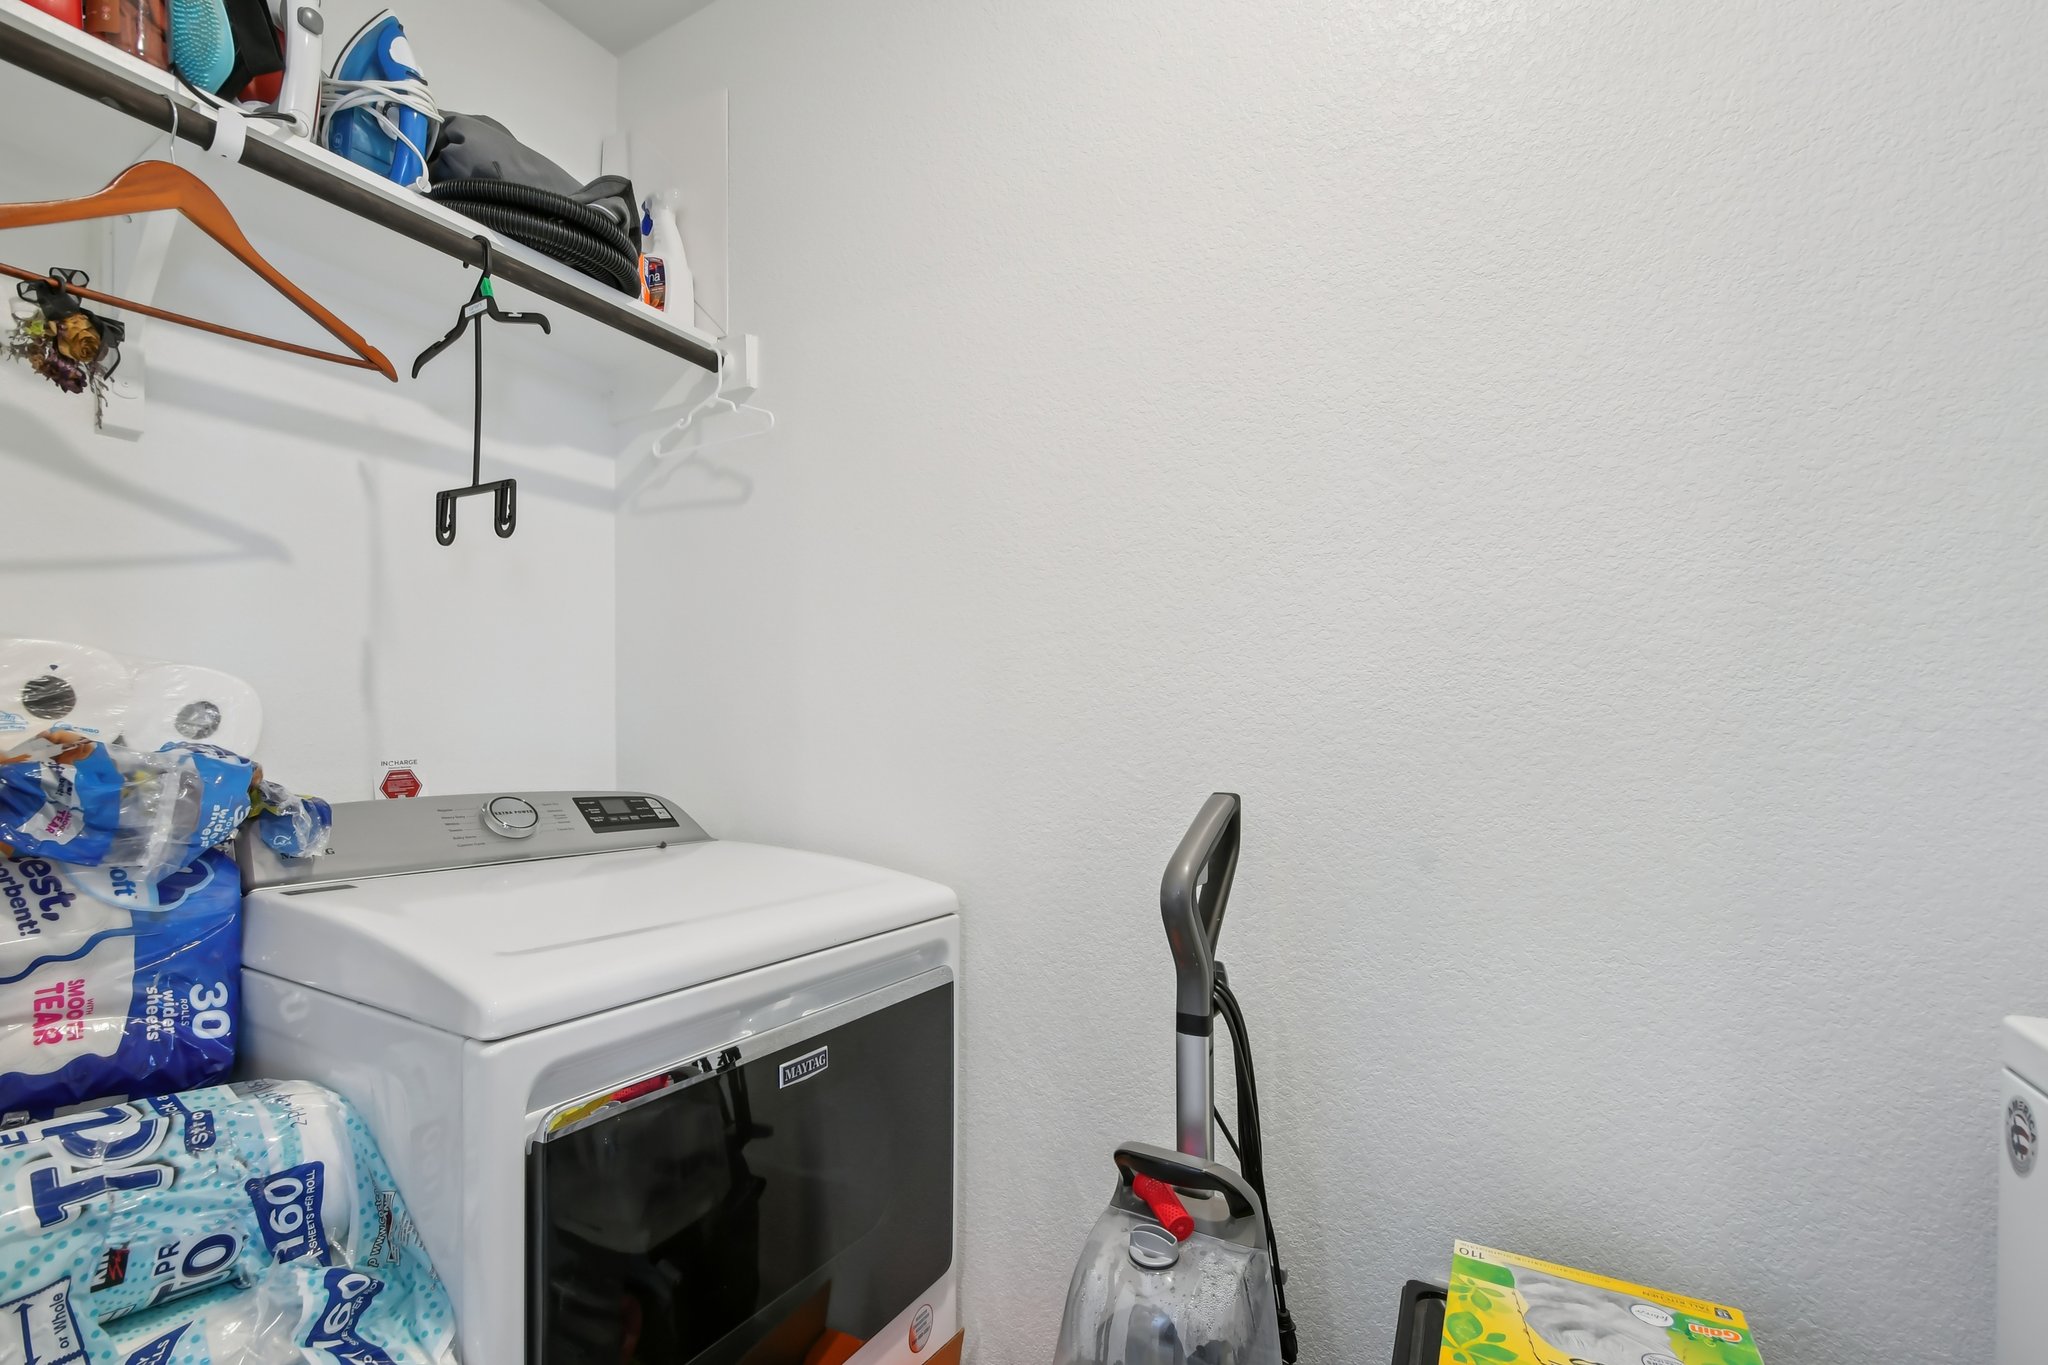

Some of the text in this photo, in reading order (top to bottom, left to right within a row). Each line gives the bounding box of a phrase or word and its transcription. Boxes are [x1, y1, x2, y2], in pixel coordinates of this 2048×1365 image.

[380, 759, 418, 767] INCHARGE
[45, 810, 67, 834] TEAR
[0, 863, 41, 937] orbent!
[15, 857, 77, 921] est,
[109, 866, 137, 897] oft
[33, 981, 65, 1047] TEAR
[66, 978, 86, 1042] SMOOTH
[85, 997, 96, 1015] WITH
[145, 986, 161, 1042] sheets
[161, 989, 180, 1034] wider
[179, 998, 190, 1027] ROLLS
[189, 981, 231, 1040] 30
[784, 1053, 826, 1082] MAYTAG
[2008, 1099, 2037, 1144] AMERICA
[306, 1169, 316, 1194] ROLL
[264, 1177, 305, 1253] 160
[305, 1212, 318, 1249] SHEETS
[1458, 1246, 1486, 1260] 110
[49, 1292, 70, 1350] or Whole
[312, 1273, 371, 1349] 160
[1687, 1322, 1743, 1343] Gain
